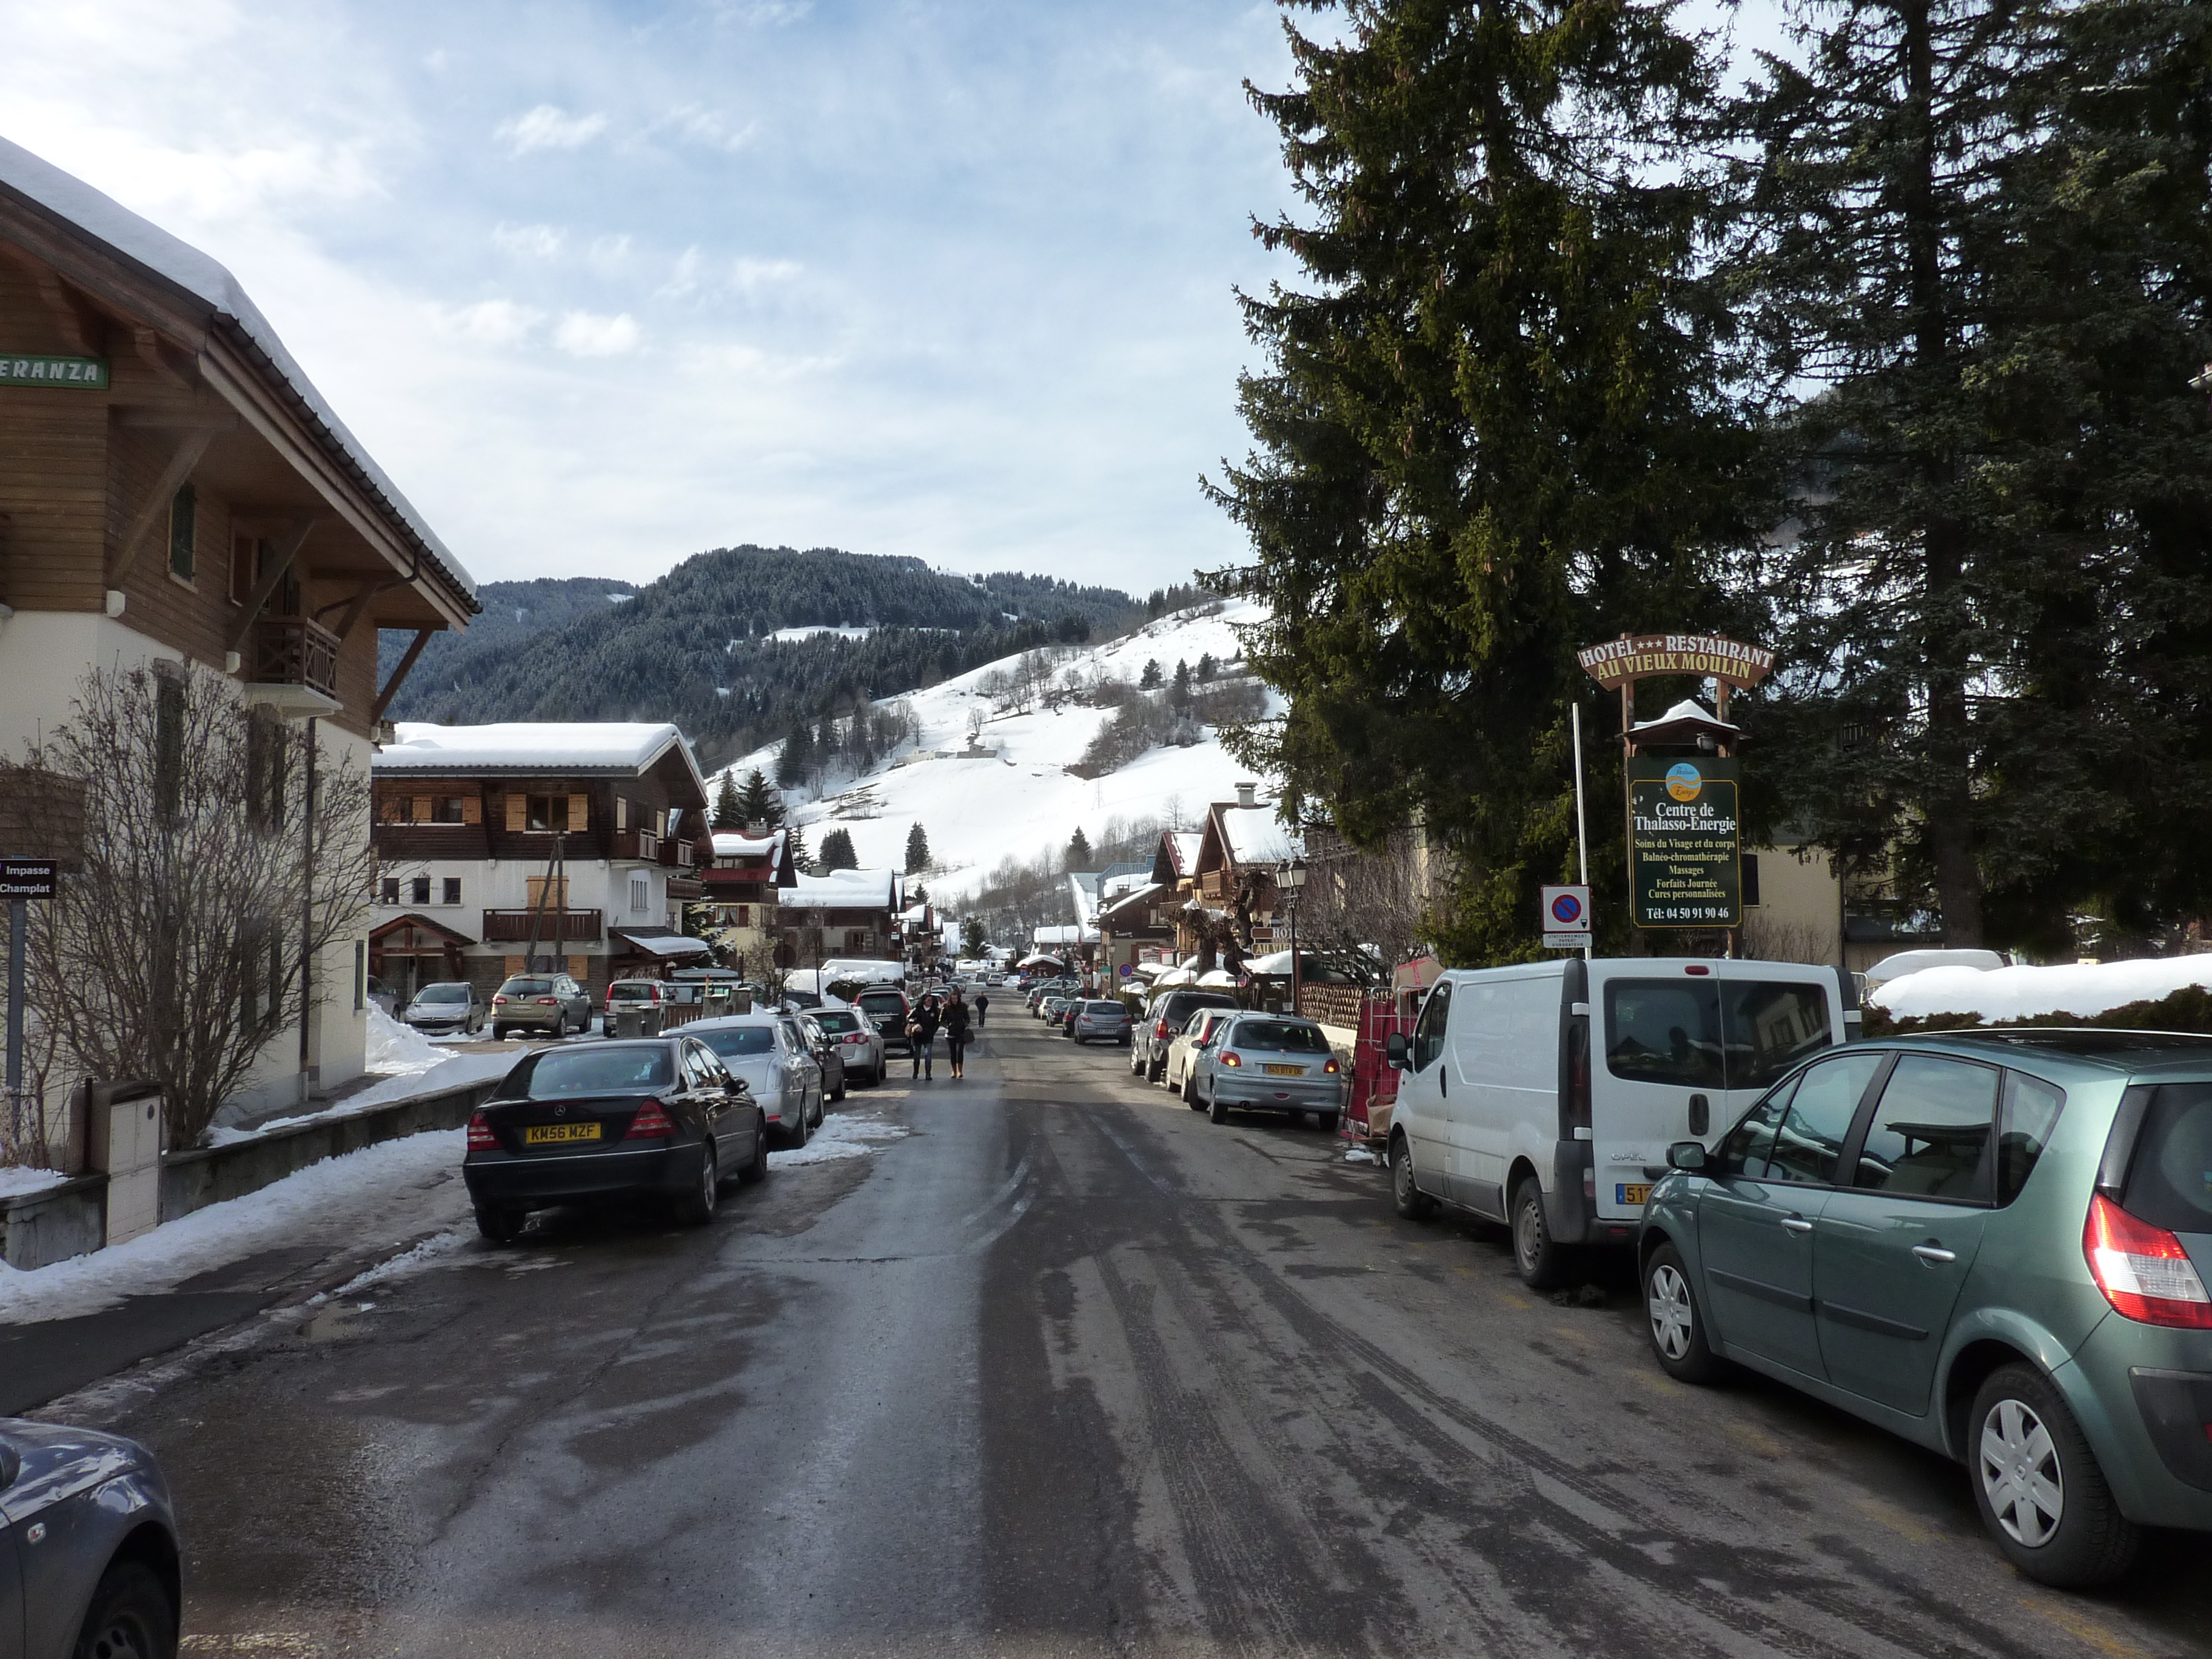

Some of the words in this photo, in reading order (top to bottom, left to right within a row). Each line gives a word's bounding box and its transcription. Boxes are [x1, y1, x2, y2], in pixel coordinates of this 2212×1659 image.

[1581, 640, 1636, 667] HOTEL
[1666, 635, 1774, 668] RESTAURANT
[1598, 659, 1621, 680] AU
[1623, 653, 1677, 673] VIEUX
[1681, 653, 1751, 679] MOULIN
[1655, 802, 1696, 817] Centre
[1700, 803, 1714, 817] de
[1634, 816, 1736, 834] Thalasso-Energie
[1635, 839, 1655, 848] Soins
[1657, 839, 1667, 848] du
[1669, 839, 1693, 850] Visage
[1695, 840, 1701, 848] et
[1703, 839, 1713, 848] du
[1715, 840, 1735, 850] corps
[1643, 851, 1729, 863] Balnéo-chromathérapie
[7, 866, 50, 877] Impasse
[1669, 865, 1704, 877] Massages
[0, 883, 50, 894] Champlat
[1656, 879, 1686, 888] Forfaits
[1687, 878, 1718, 888] Journée
[1648, 889, 1671, 899] Cures
[1672, 889, 1726, 900] personnalisées
[1646, 908, 1664, 919] Tél:
[1666, 908, 1677, 919] 04
[1680, 908, 1691, 918] 50
[1692, 908, 1702, 918] 91
[1705, 908, 1715, 918] 90
[1717, 907, 1729, 918] 46
[1256, 944, 1269, 953] AU
[532, 1127, 566, 1141] KM56
[570, 1125, 595, 1138] MZF
[1627, 1187, 1652, 1202] 51
